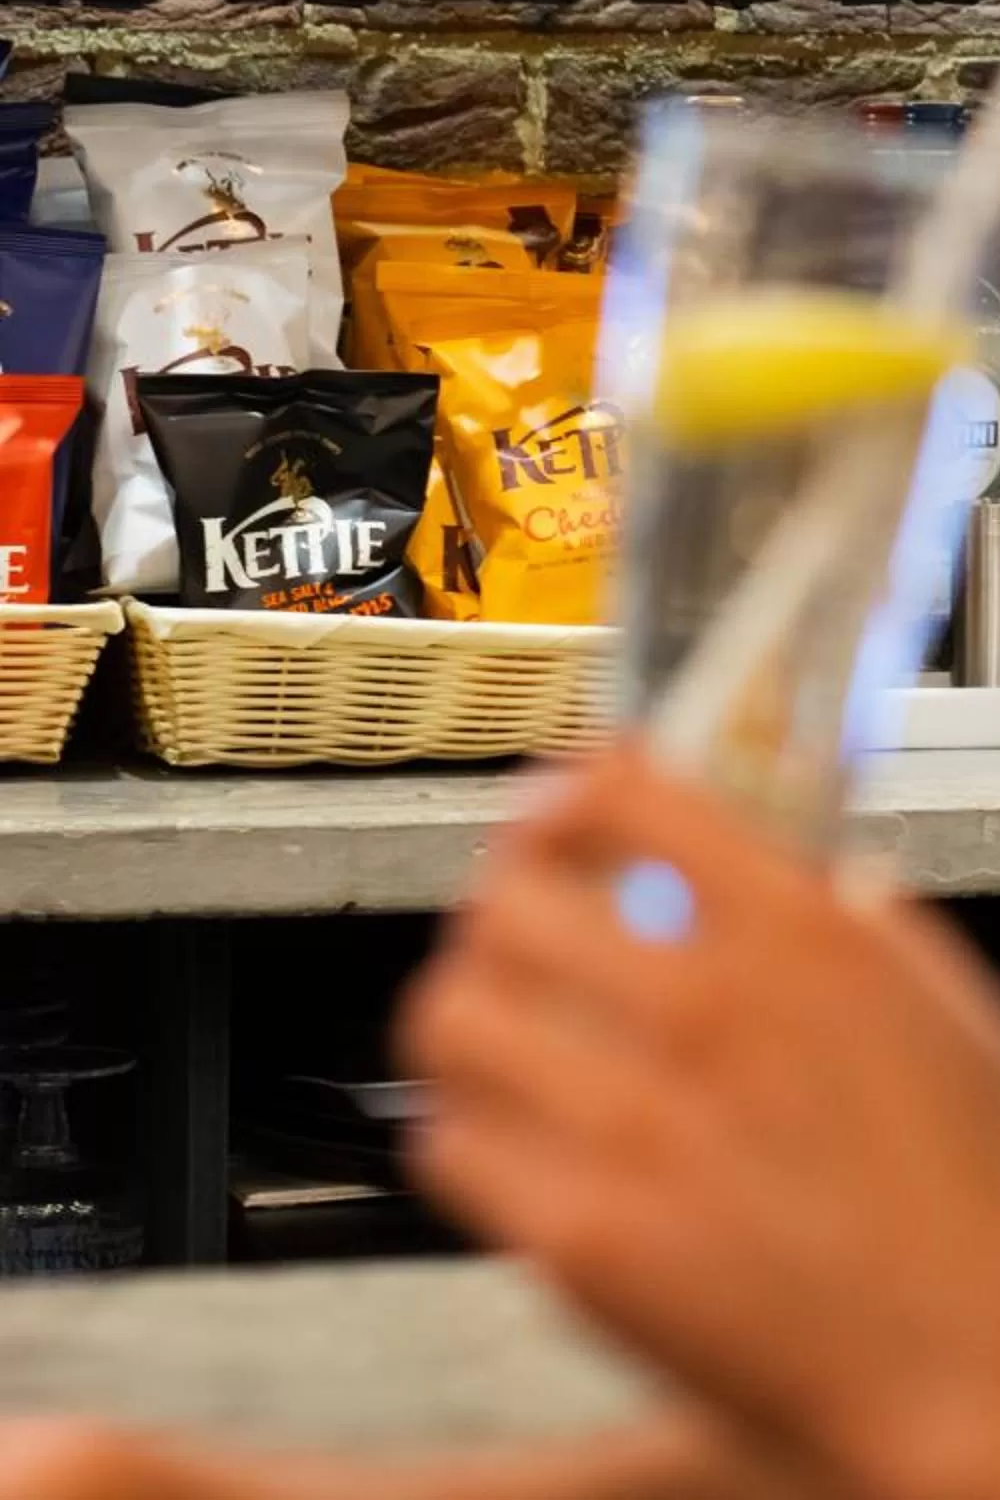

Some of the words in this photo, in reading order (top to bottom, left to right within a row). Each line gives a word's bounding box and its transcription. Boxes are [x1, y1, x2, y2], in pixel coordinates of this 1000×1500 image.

[491, 402, 626, 492] KETT
[200, 496, 387, 593] KETTLE
[523, 501, 623, 542] Ched
